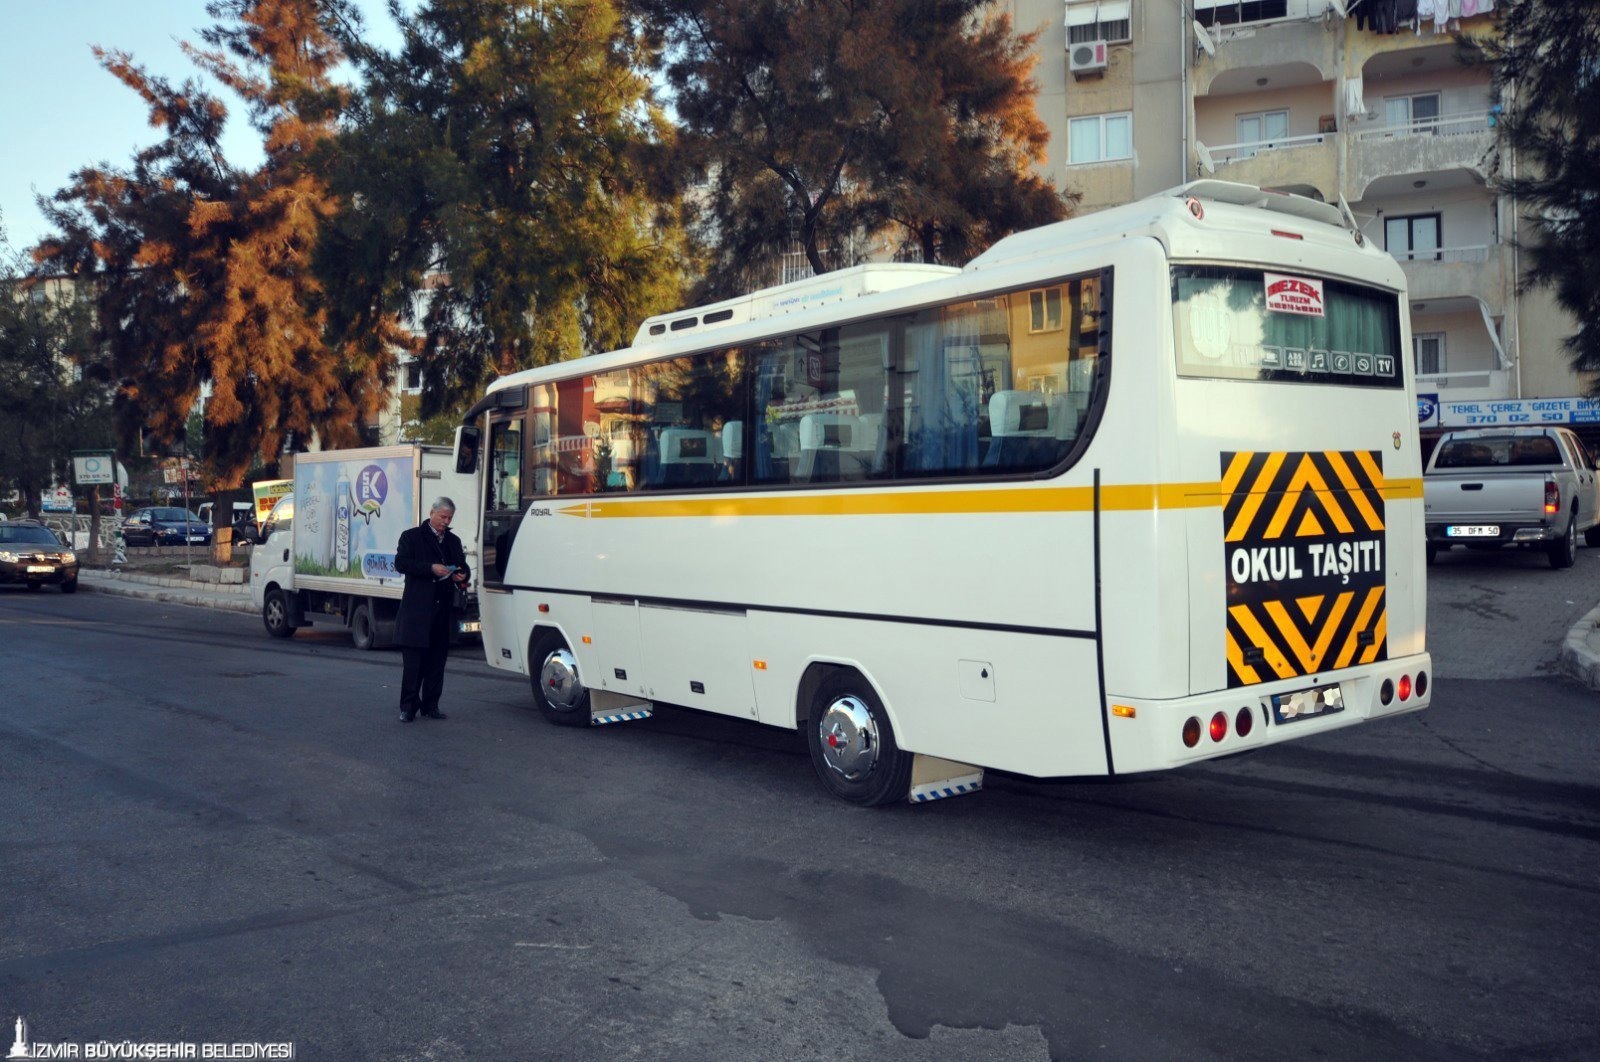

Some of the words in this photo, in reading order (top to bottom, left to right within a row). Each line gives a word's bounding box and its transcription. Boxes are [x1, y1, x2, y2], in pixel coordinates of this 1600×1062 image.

[1267, 279, 1322, 304] BEZEK
[1378, 360, 1391, 372] TV
[1452, 404, 1482, 414] TEKEL
[1491, 403, 1522, 414] ÇEREZ
[1532, 401, 1570, 411] GAZETE
[1466, 415, 1498, 424] 370
[1508, 413, 1530, 422] 02
[1541, 412, 1563, 421] 50
[530, 508, 552, 516] ROYAL
[1231, 546, 1303, 584] OKUL
[1308, 539, 1381, 585] TAŞITI
